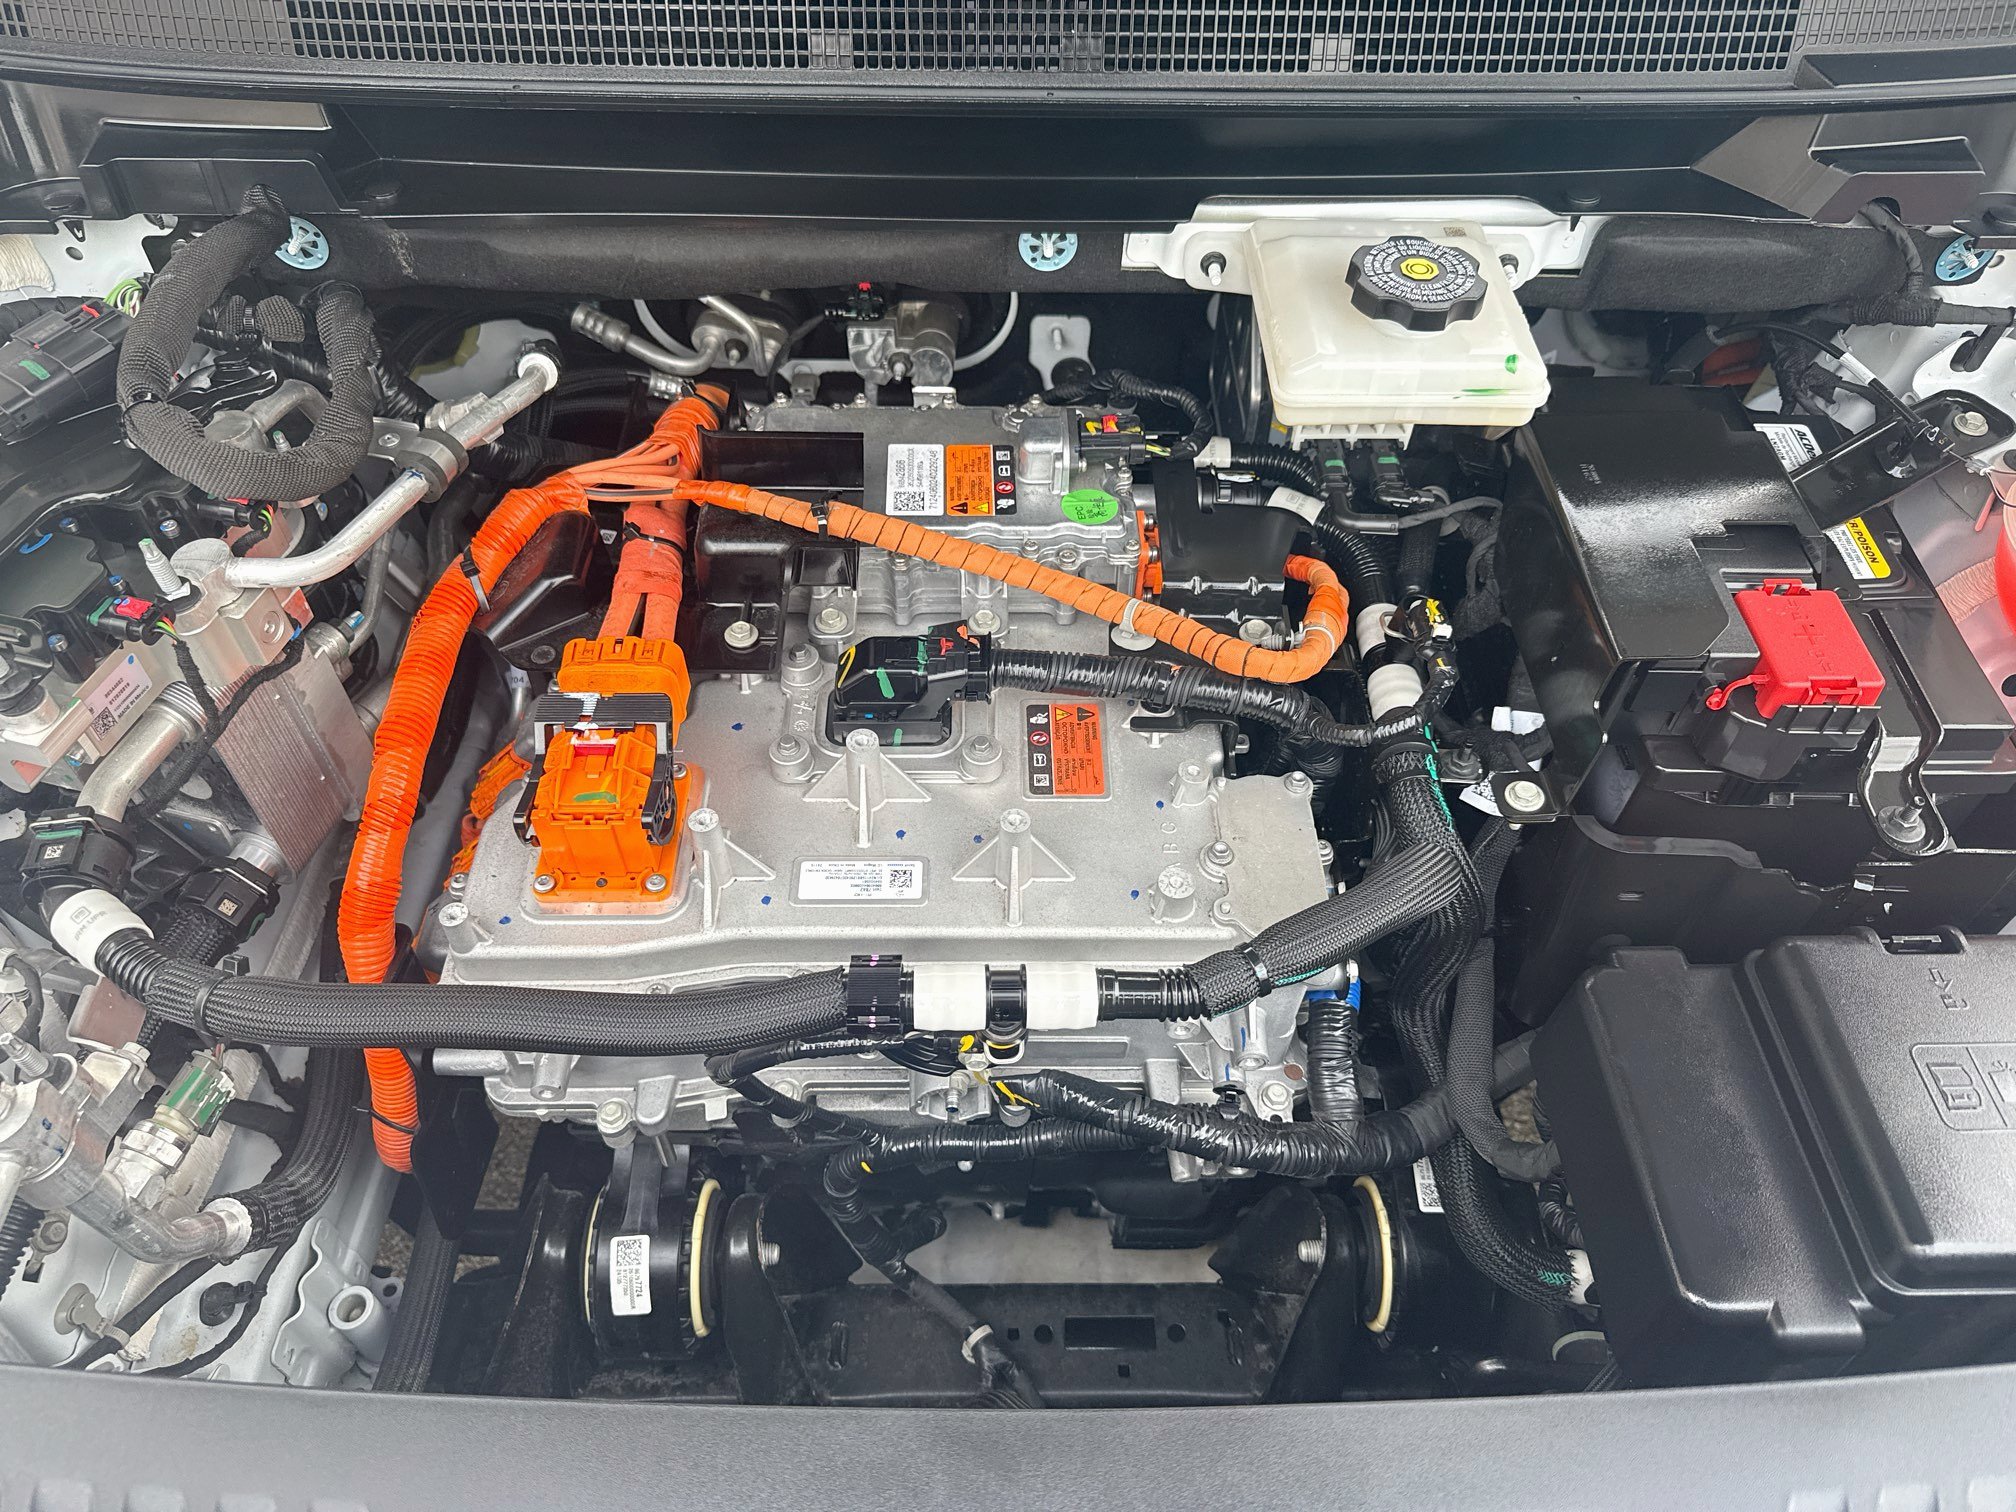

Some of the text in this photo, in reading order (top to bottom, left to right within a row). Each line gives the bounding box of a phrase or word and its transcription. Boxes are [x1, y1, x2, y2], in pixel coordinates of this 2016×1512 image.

[1405, 239, 1439, 249] BOUCHON
[1419, 250, 1439, 260] BIDON
[1381, 284, 1402, 297] FLUID
[1401, 292, 1422, 301] FROM
[1387, 280, 1412, 292] BEFORE
[1075, 506, 1087, 520] EPC
[1848, 520, 1880, 563] R/POISON
